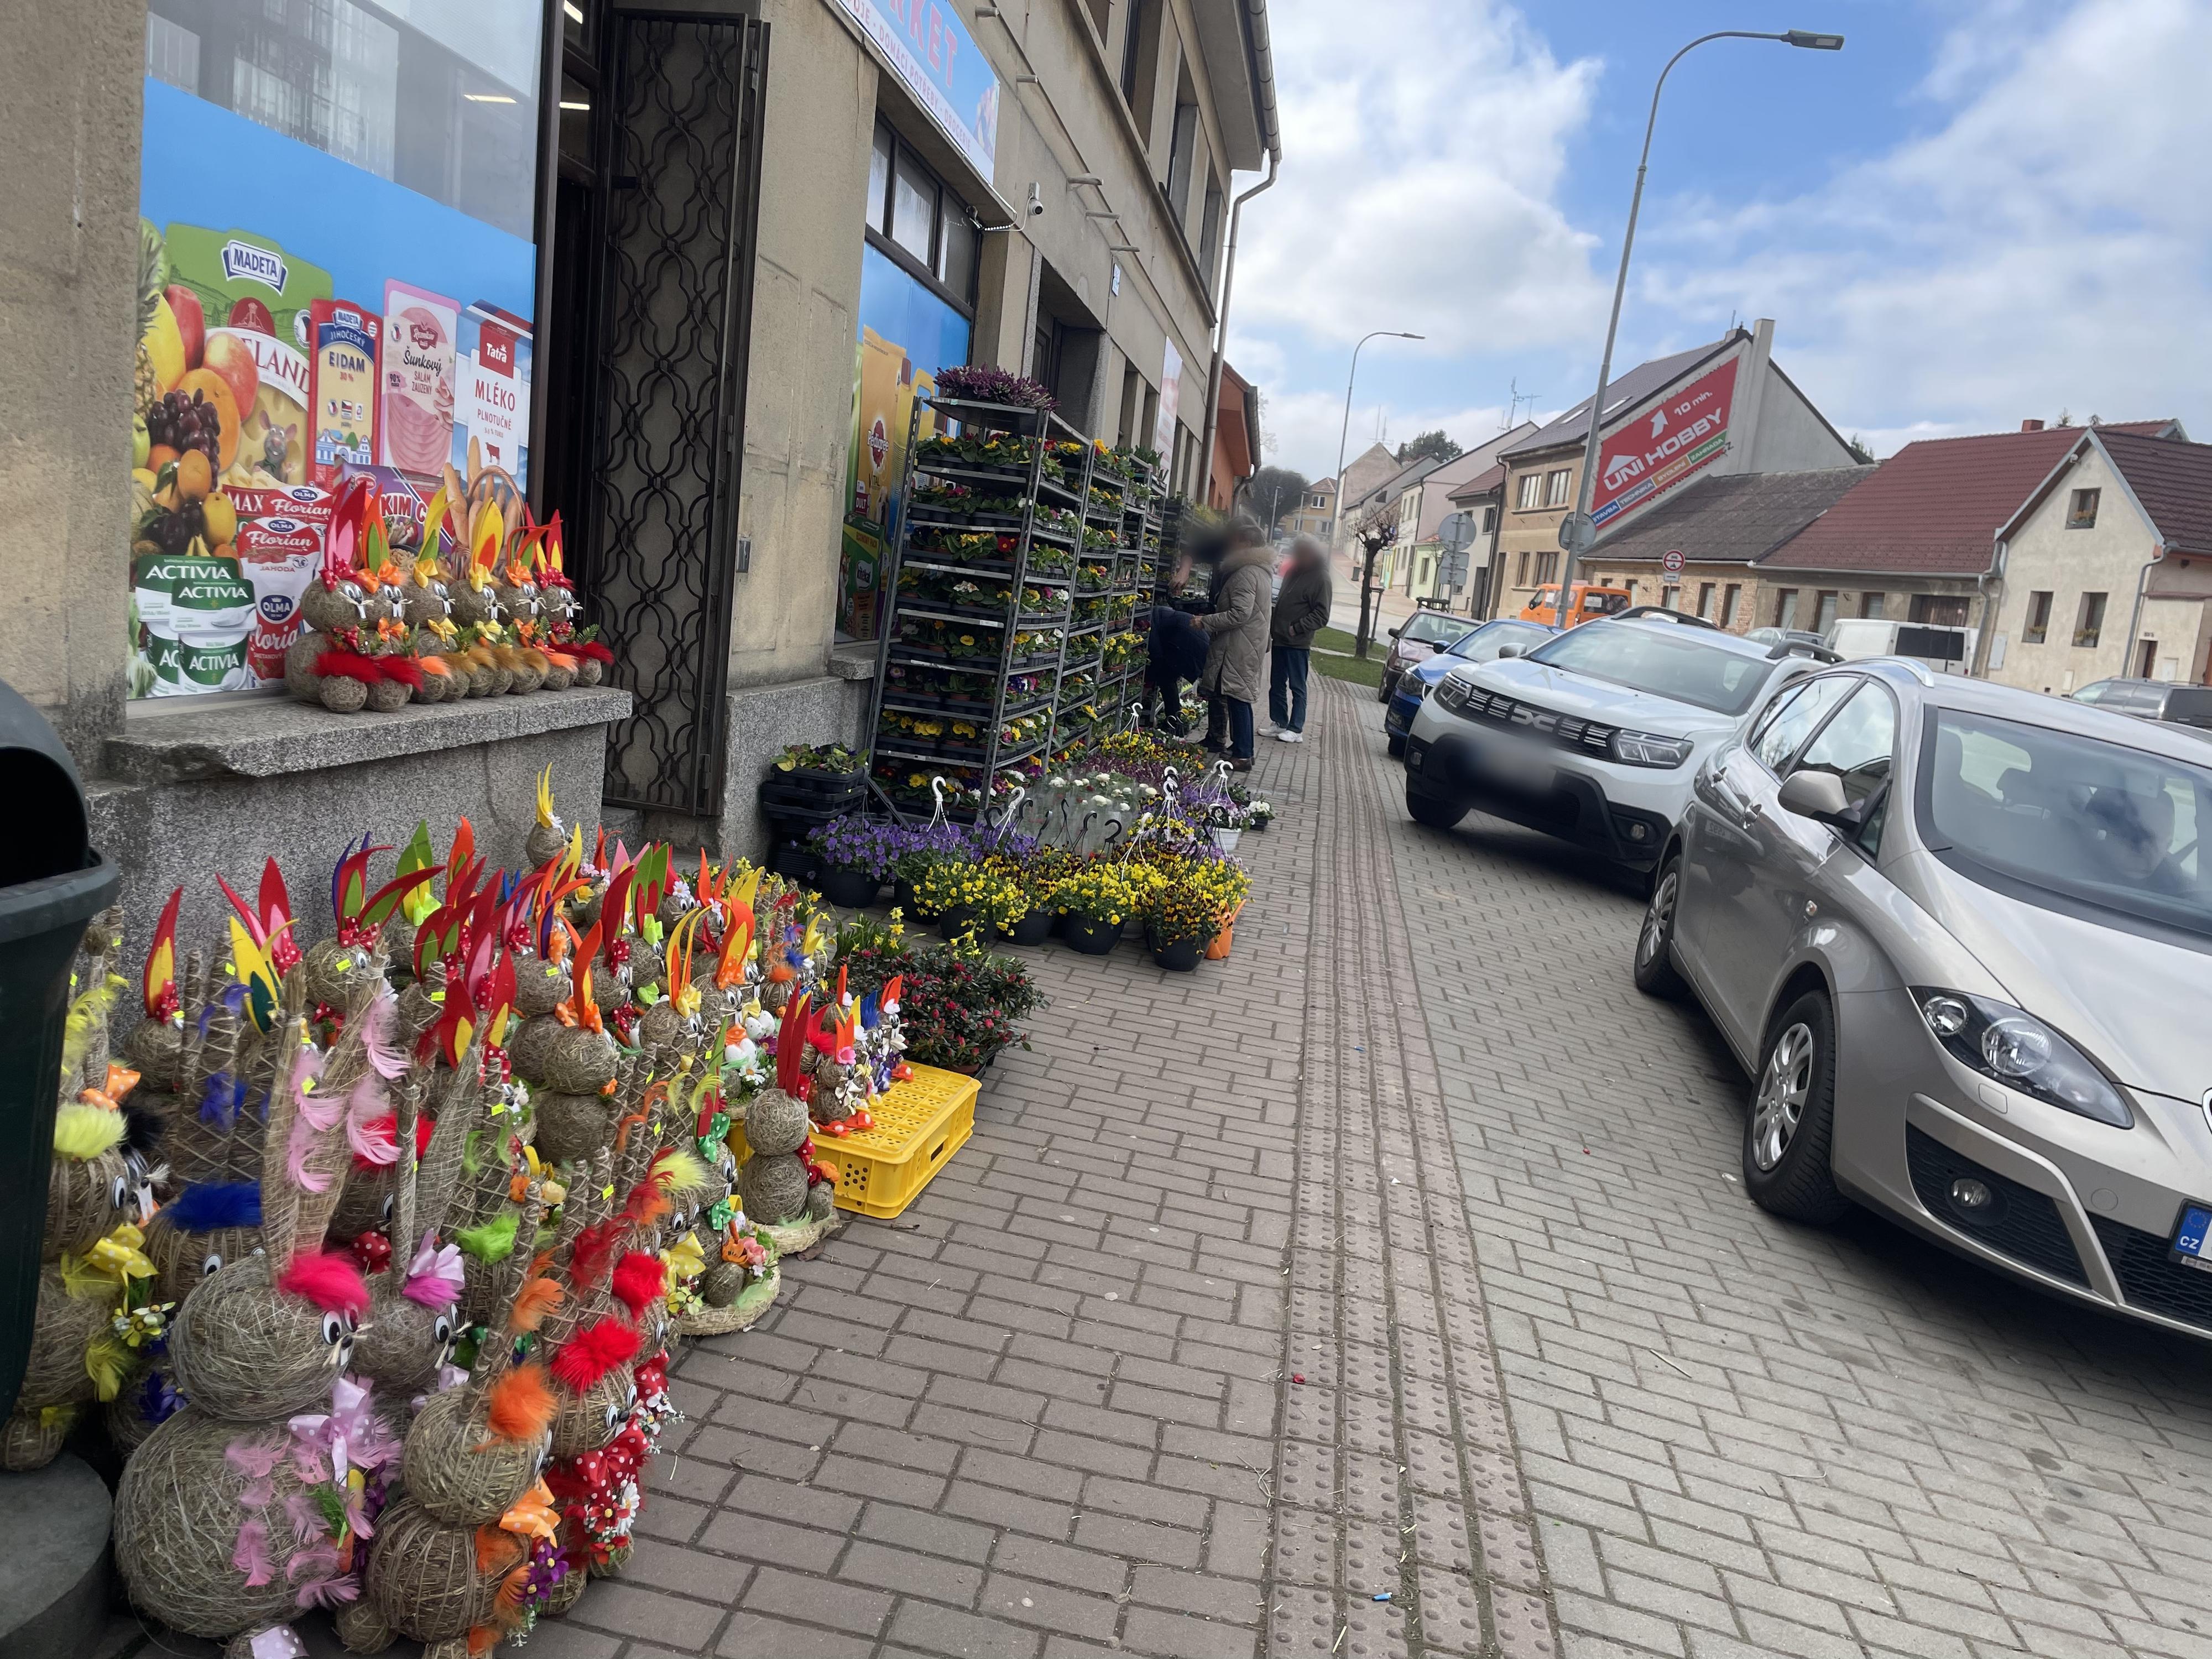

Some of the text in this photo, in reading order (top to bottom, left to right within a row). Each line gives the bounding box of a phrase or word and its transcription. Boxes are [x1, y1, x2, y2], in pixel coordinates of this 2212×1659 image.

[879, 25, 908, 71] DOMÁCÍ
[910, 64, 939, 110] POTŘEBY
[944, 105, 971, 152] DROGERIE
[234, 248, 278, 278] MADETA
[329, 351, 365, 373] EIDAM
[404, 346, 442, 377] Šunkový
[486, 342, 507, 363] Tatra
[475, 378, 515, 411] MLÉKO
[1674, 391, 1713, 416] 10 min.
[477, 408, 512, 430] PLNOTUČNÉ
[867, 429, 889, 453] Pedigree
[1604, 406, 1721, 491] UNI HOBBY
[1619, 482, 1654, 505] TECHNIKA
[1689, 438, 1724, 462] ZAHRADA
[270, 499, 332, 515] Florian
[246, 531, 313, 547] Florian
[145, 565, 232, 580] ACTIVIA
[178, 587, 249, 598] ACTIVIA
[263, 601, 291, 613] OLMA
[251, 624, 299, 650] loria
[189, 653, 239, 671] ACTIVIA
[2180, 1235, 2200, 1250] CZ
